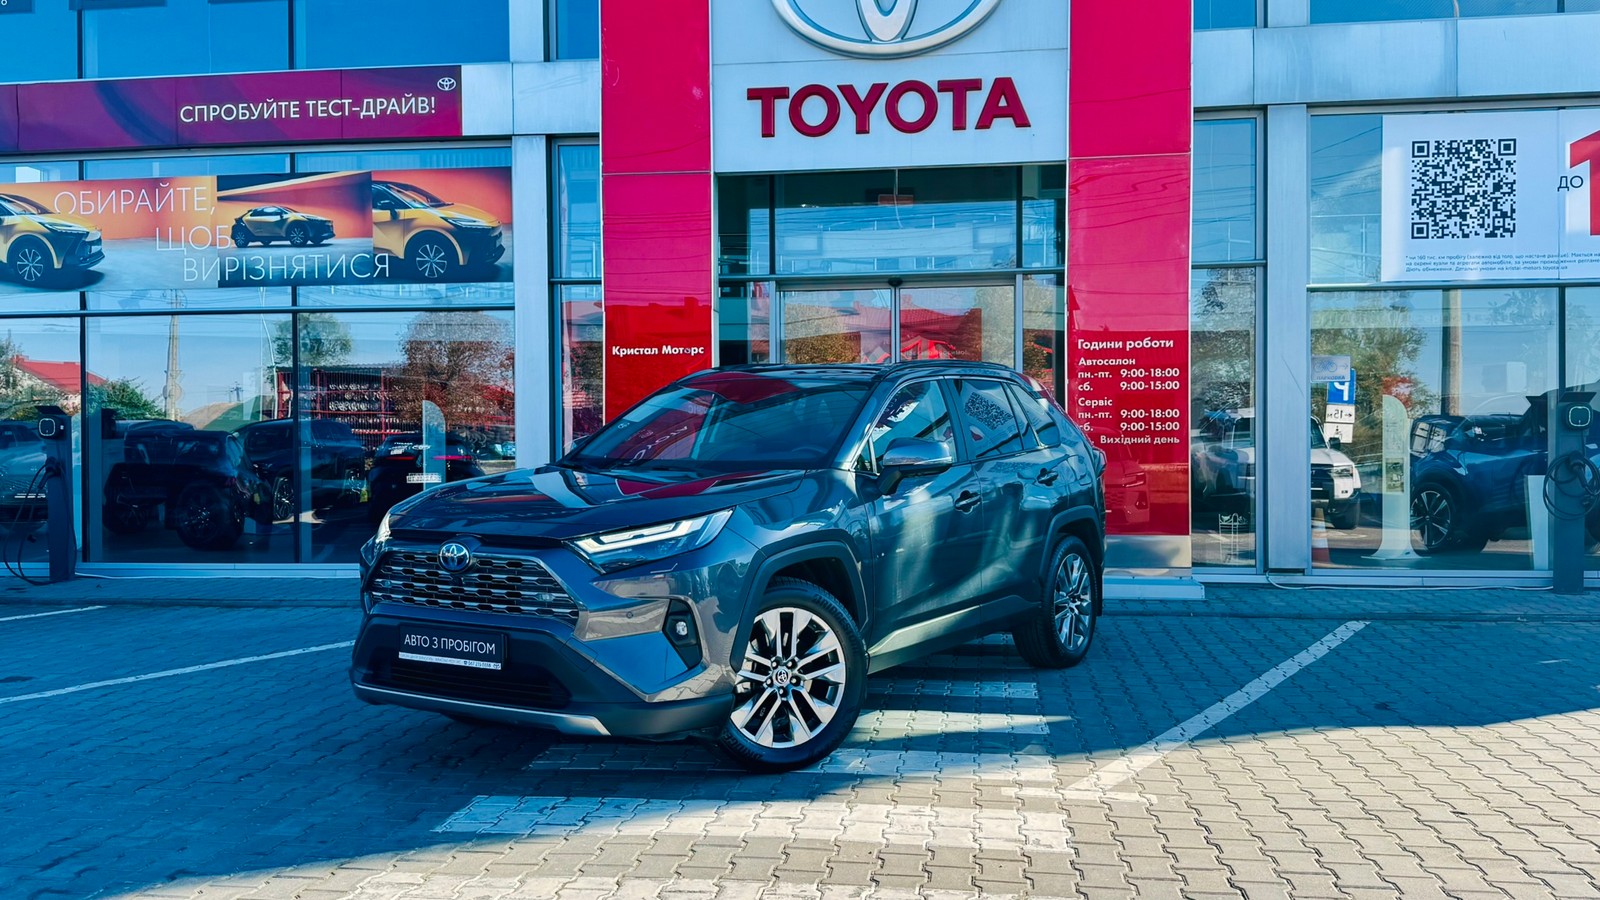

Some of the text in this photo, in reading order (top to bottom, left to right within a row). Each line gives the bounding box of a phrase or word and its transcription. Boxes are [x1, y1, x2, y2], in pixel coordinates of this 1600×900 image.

[179, 92, 437, 124] СПРОБУЙТЕ ТЕСТ-ДРАЙВ!
[747, 77, 1032, 138] TOYOTA
[53, 183, 217, 217] ОБИРАЙТЕ,
[155, 225, 232, 253] ЩОБ
[183, 253, 390, 283] ВИРІЗНЯТИСЯ
[1077, 337, 1174, 351] Години роботи
[612, 345, 705, 358] Кристал Моторс
[1078, 357, 1136, 366] Автосалон
[1078, 368, 1180, 379] пн.-пт. 9:00-18:00
[1078, 381, 1180, 391] сб. 9:00-15:00
[1078, 397, 1113, 408] Сервіс
[1078, 409, 1180, 419] пн.-пт. 9:00-18:00
[1120, 422, 1180, 431] 9:00-15:00
[1100, 434, 1180, 445] Вихідний день
[404, 634, 430, 648] АВТО
[440, 637, 496, 655] ПРОБІГОМ
